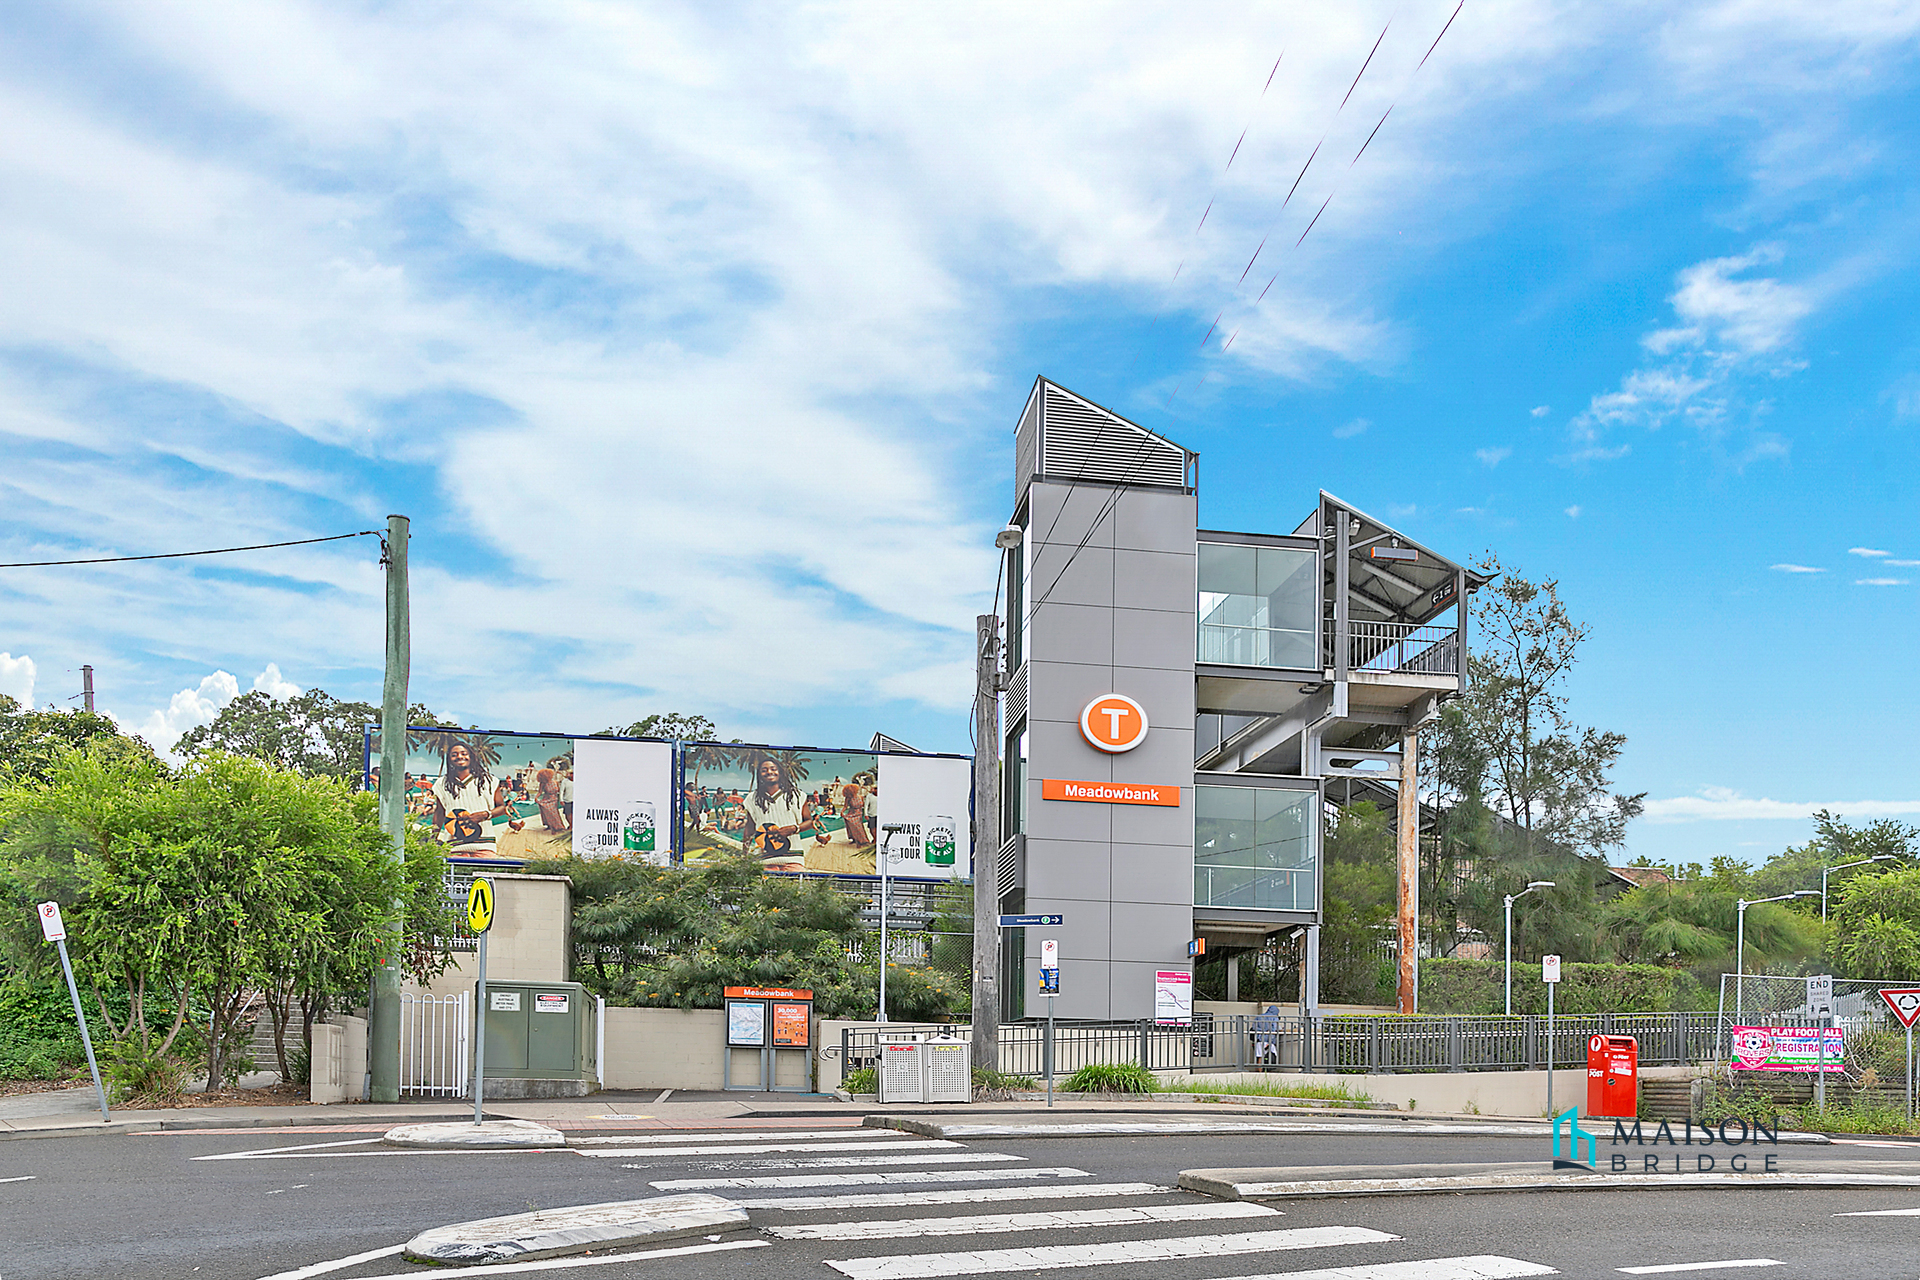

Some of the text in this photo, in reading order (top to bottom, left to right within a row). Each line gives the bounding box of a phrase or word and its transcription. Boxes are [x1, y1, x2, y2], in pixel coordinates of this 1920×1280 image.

[1101, 708, 1129, 740] T
[1065, 784, 1159, 801] Meadowbank
[586, 808, 619, 821] ALWAYS
[607, 822, 619, 833] ON
[891, 823, 920, 835] WAYS
[597, 834, 619, 846] TOUR
[909, 836, 920, 847] ON
[900, 848, 920, 859] TOUR
[1810, 980, 1829, 989] END
[1771, 1028, 1842, 1037] PLAY FOOTALL
[1738, 1048, 1770, 1057] ROVERS
[1776, 1043, 1842, 1053] REGISTRAION
